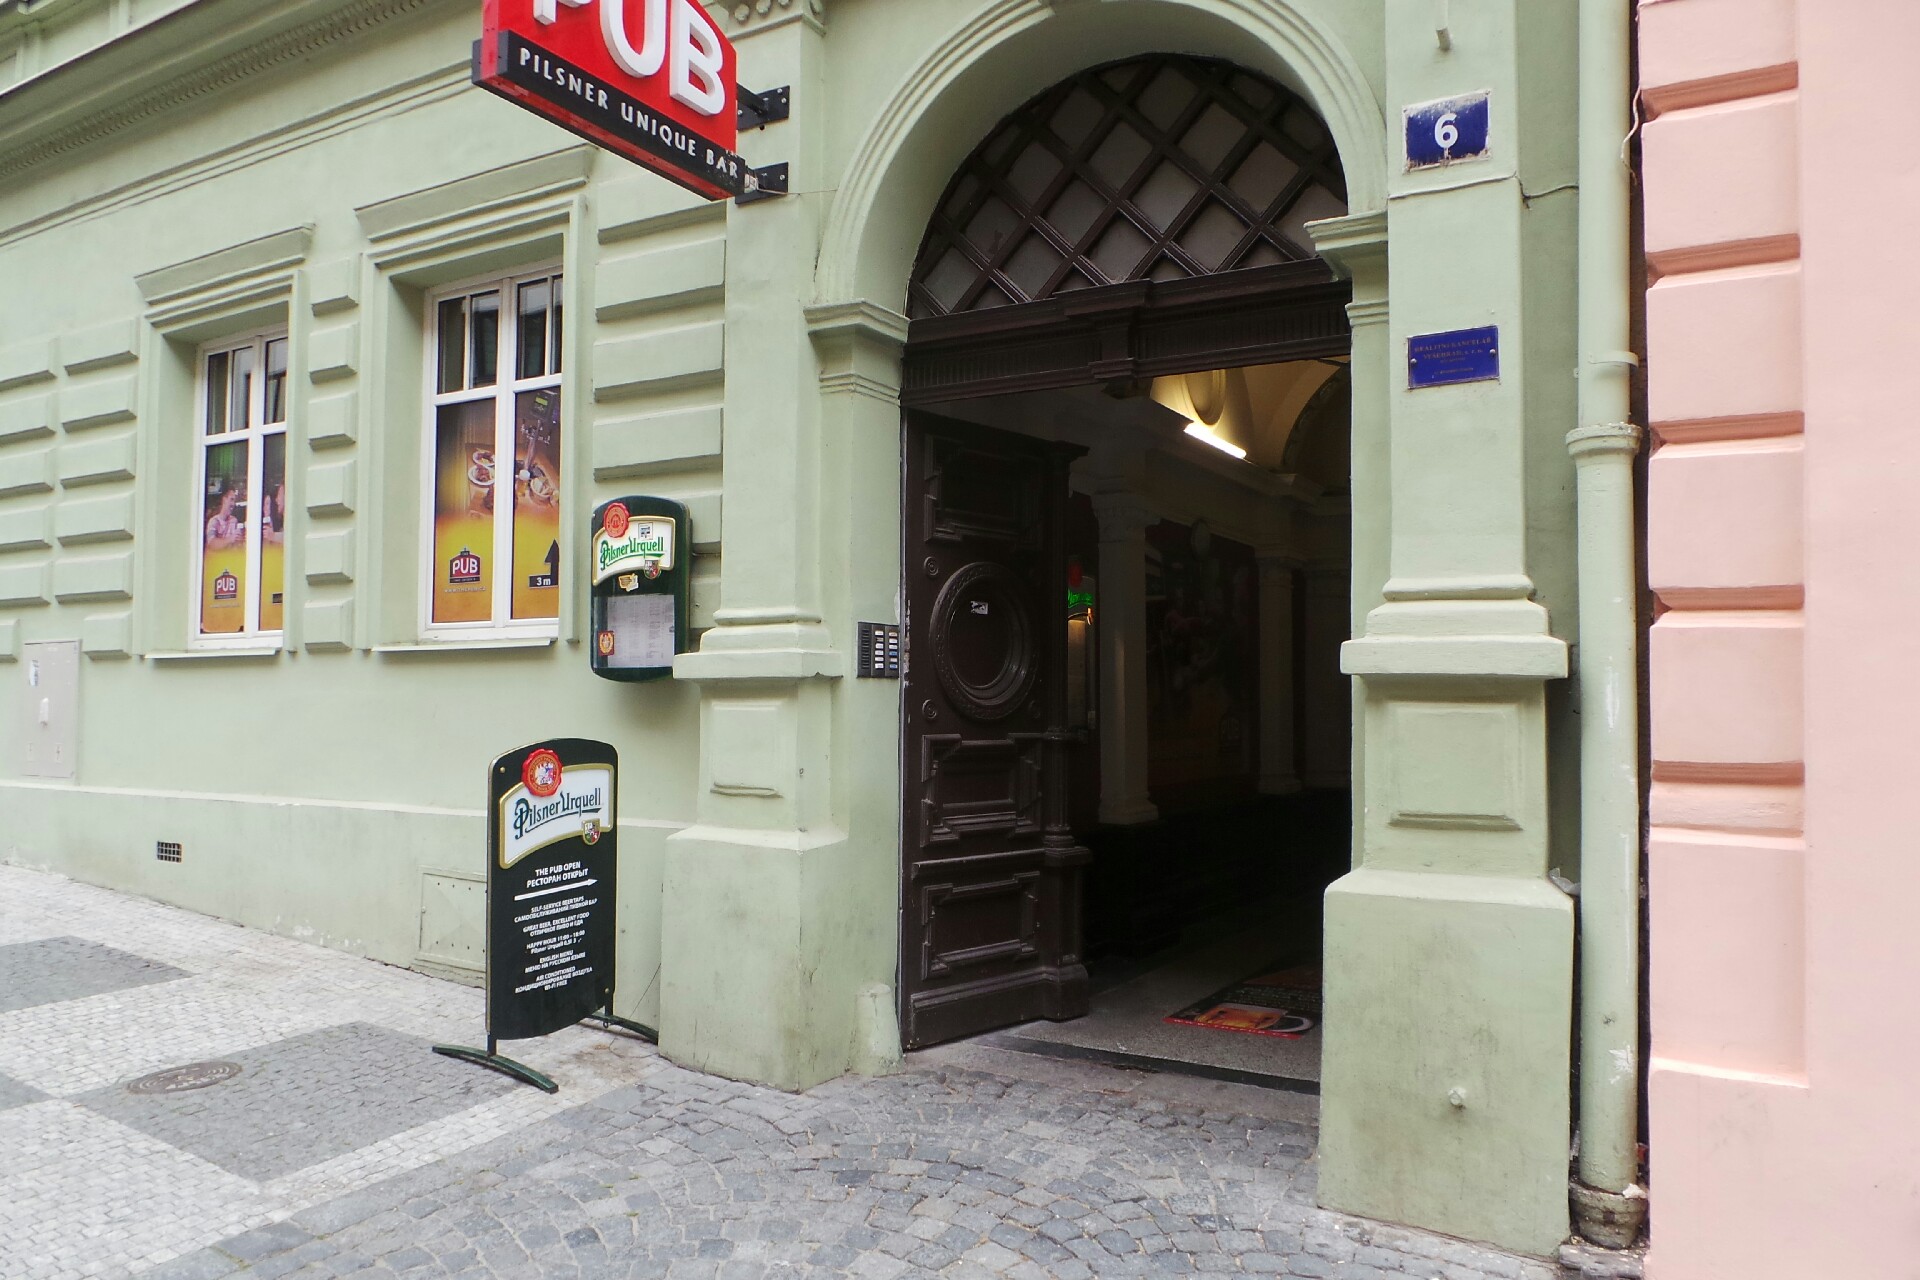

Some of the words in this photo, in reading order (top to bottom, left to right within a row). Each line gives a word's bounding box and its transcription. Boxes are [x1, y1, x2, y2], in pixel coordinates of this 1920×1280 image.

[519, 47, 609, 110] PILSNER
[620, 102, 696, 157] UNIQUE
[706, 148, 738, 180] BAR
[1434, 112, 1458, 148] 6
[600, 540, 632, 572] Pilsner
[628, 536, 664, 558] Urquell
[452, 557, 478, 575] PUB
[216, 577, 236, 593] PUB
[536, 576, 542, 586] 3
[513, 798, 561, 840] Pilsner
[560, 787, 601, 818] Urquell
[526, 874, 562, 888] РЕСТОРАН
[562, 868, 589, 880] ОТКРЫТ
[535, 867, 548, 877] THE
[550, 864, 562, 874] PUB
[564, 860, 581, 872] OPEN
[526, 940, 543, 950] HAPPY
